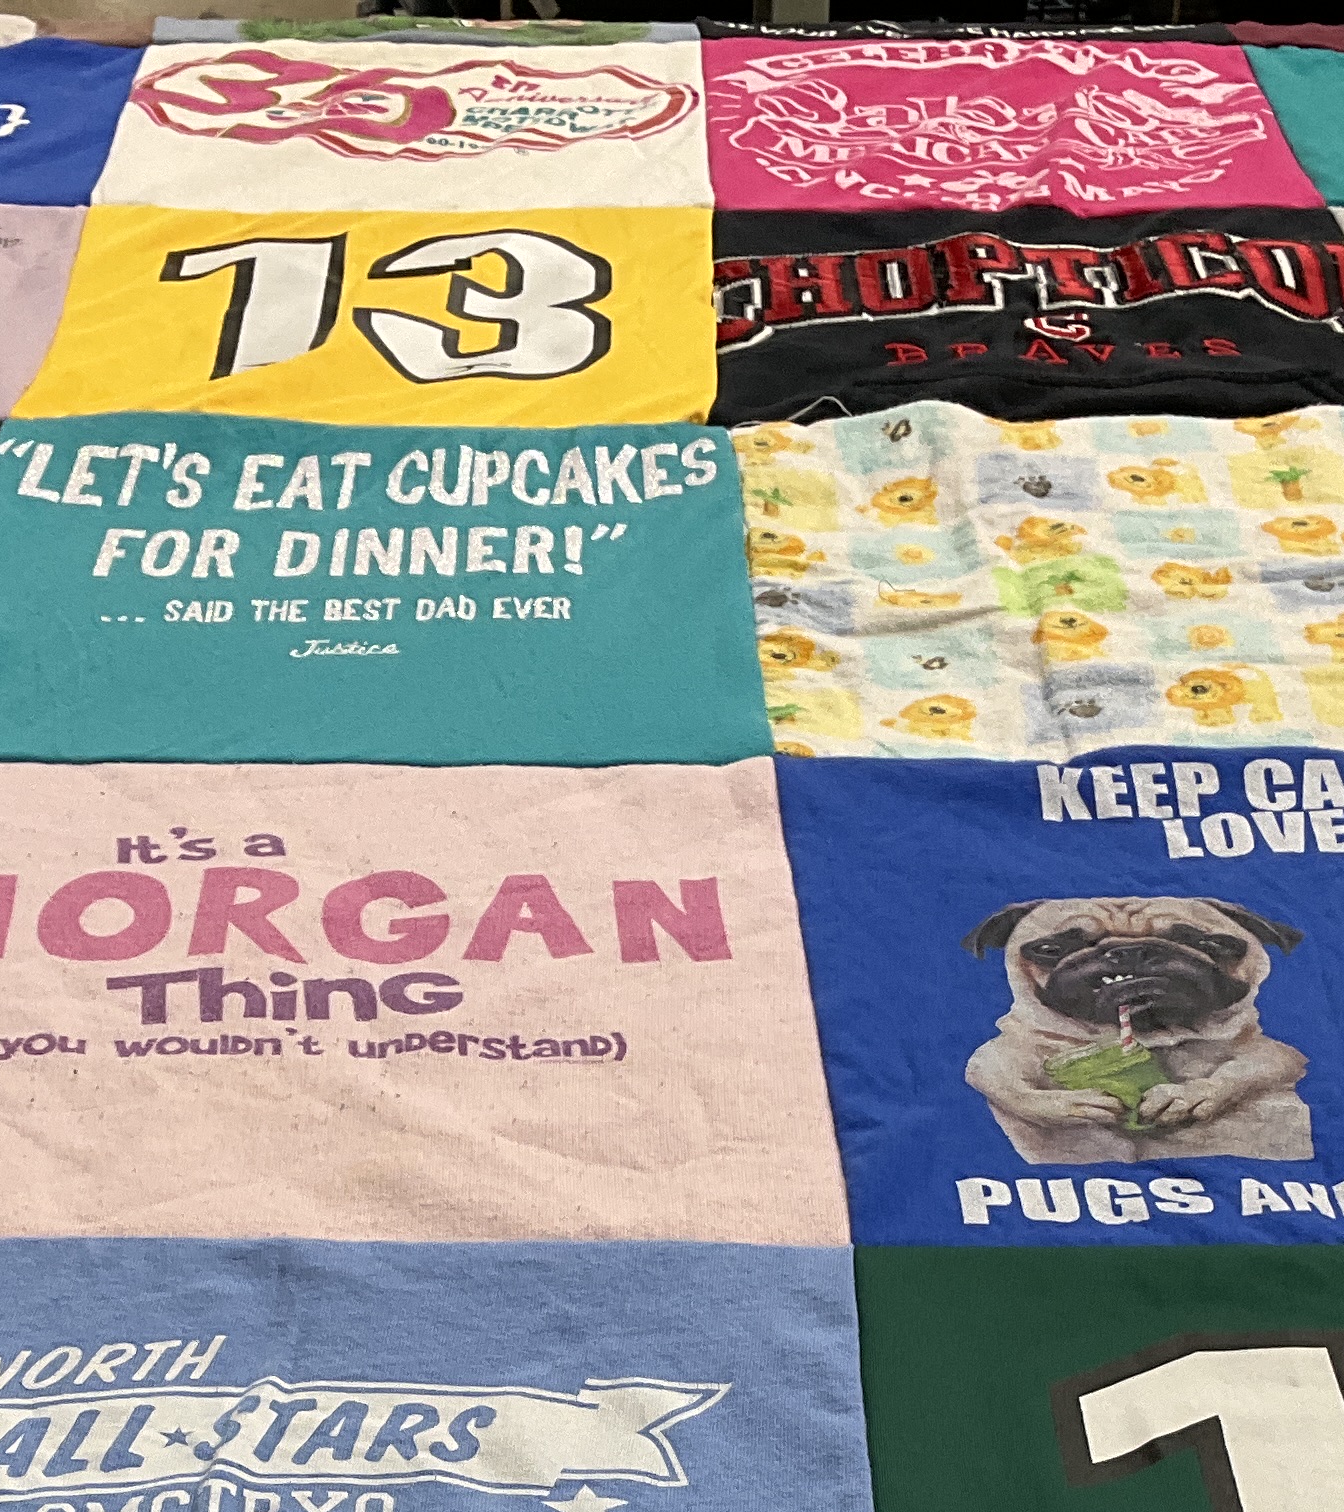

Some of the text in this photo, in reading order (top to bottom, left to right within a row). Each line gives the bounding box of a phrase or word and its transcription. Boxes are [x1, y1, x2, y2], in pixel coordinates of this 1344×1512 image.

[159, 228, 612, 385] 13
[233, 451, 371, 512] EAT
[386, 436, 719, 507] CUPCAKES
[91, 527, 241, 579] FOR
[163, 599, 234, 623] SAID
[252, 598, 310, 623] THE
[323, 596, 402, 623] BEST
[414, 595, 478, 622] DAD
[492, 596, 572, 621] EVER
[288, 639, 401, 658] Justice
[1035, 759, 1222, 823] KEEP
[116, 826, 286, 866] It's a
[955, 1174, 1216, 1226] PUGS
[197, 1392, 499, 1465] STARS
